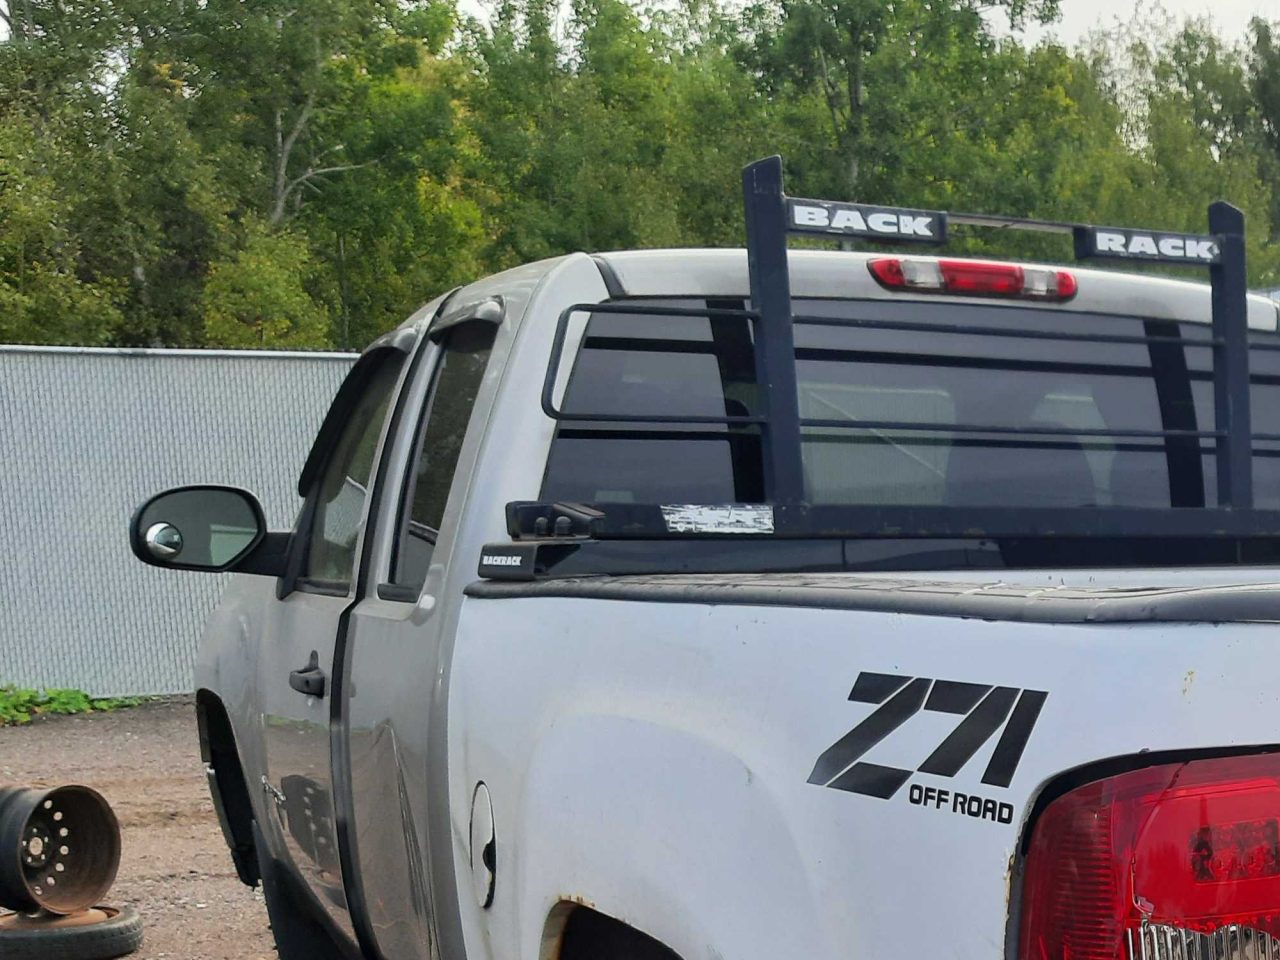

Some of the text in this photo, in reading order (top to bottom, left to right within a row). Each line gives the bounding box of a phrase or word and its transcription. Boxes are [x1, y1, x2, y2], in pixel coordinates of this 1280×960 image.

[792, 205, 1217, 259] BACK RACK
[482, 555, 522, 566] BACKRACK
[806, 671, 1050, 801] Z71
[908, 783, 1014, 825] OFF ROAD
